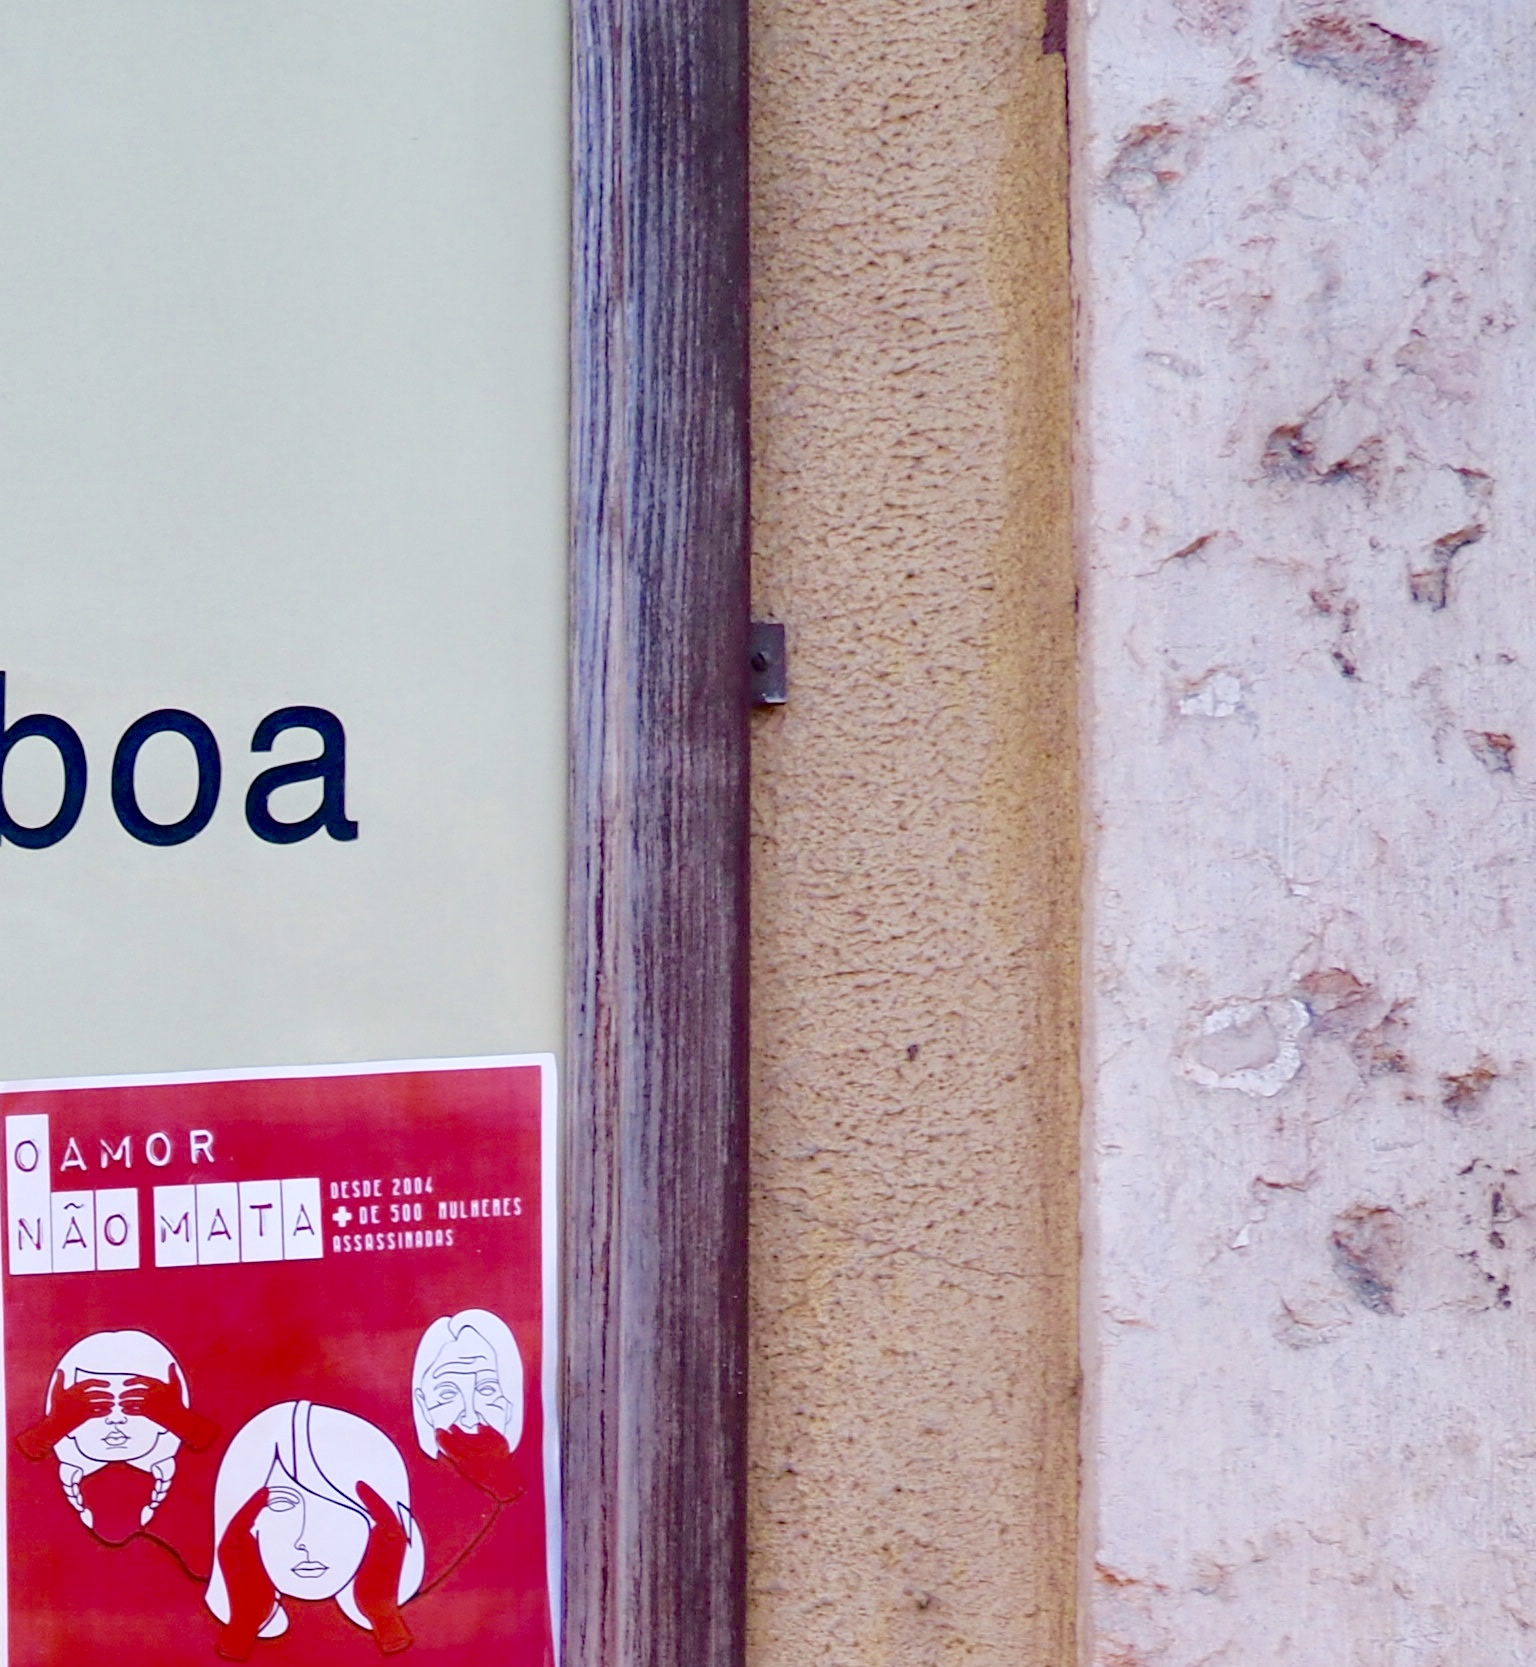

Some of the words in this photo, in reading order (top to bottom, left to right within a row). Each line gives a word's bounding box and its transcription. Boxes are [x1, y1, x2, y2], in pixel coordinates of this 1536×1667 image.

[14, 1140, 39, 1173] O
[60, 1129, 216, 1172] AMOR
[330, 1179, 383, 1200] DESDE
[392, 1176, 433, 1197] 2004
[359, 1205, 381, 1225] DE
[390, 1203, 424, 1223] 500
[438, 1197, 523, 1220] MULHERES
[18, 1202, 128, 1250] NÃO
[160, 1202, 316, 1243] MATA
[333, 1229, 454, 1253] ASSASSINADAS
